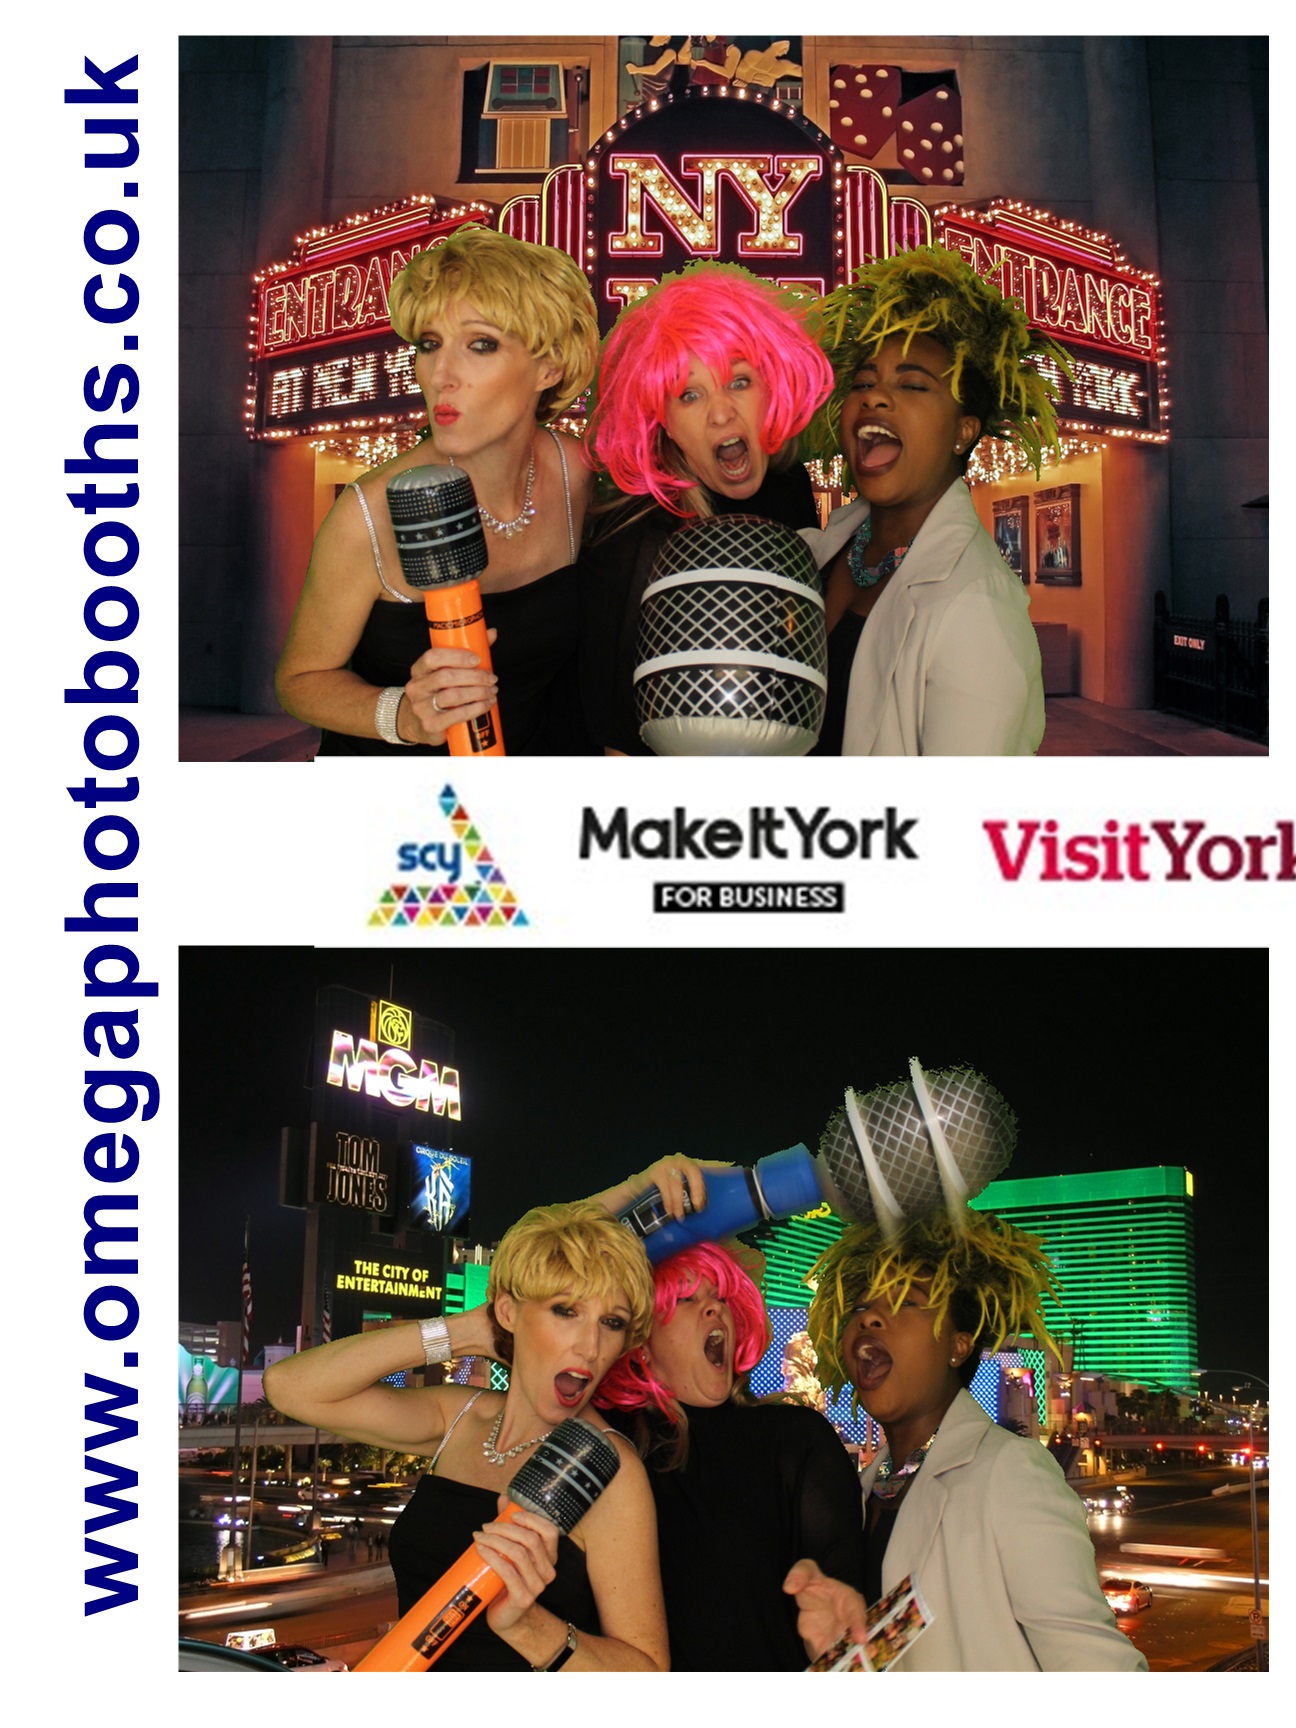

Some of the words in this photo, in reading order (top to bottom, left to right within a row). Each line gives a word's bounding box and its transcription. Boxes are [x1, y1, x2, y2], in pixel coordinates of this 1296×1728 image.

[609, 153, 823, 258] NY
[1174, 635, 1188, 647] EXIT
[1188, 637, 1205, 650] ONLY
[326, 1029, 462, 1121] MGM
[335, 1131, 380, 1174] TOM
[415, 1146, 438, 1158] CIRQUE
[327, 1172, 388, 1213] JONES
[336, 1274, 443, 1300] ENTERTAINMENT
[354, 1260, 380, 1277] THE
[382, 1264, 410, 1281] CITY
[412, 1268, 429, 1283] OF
